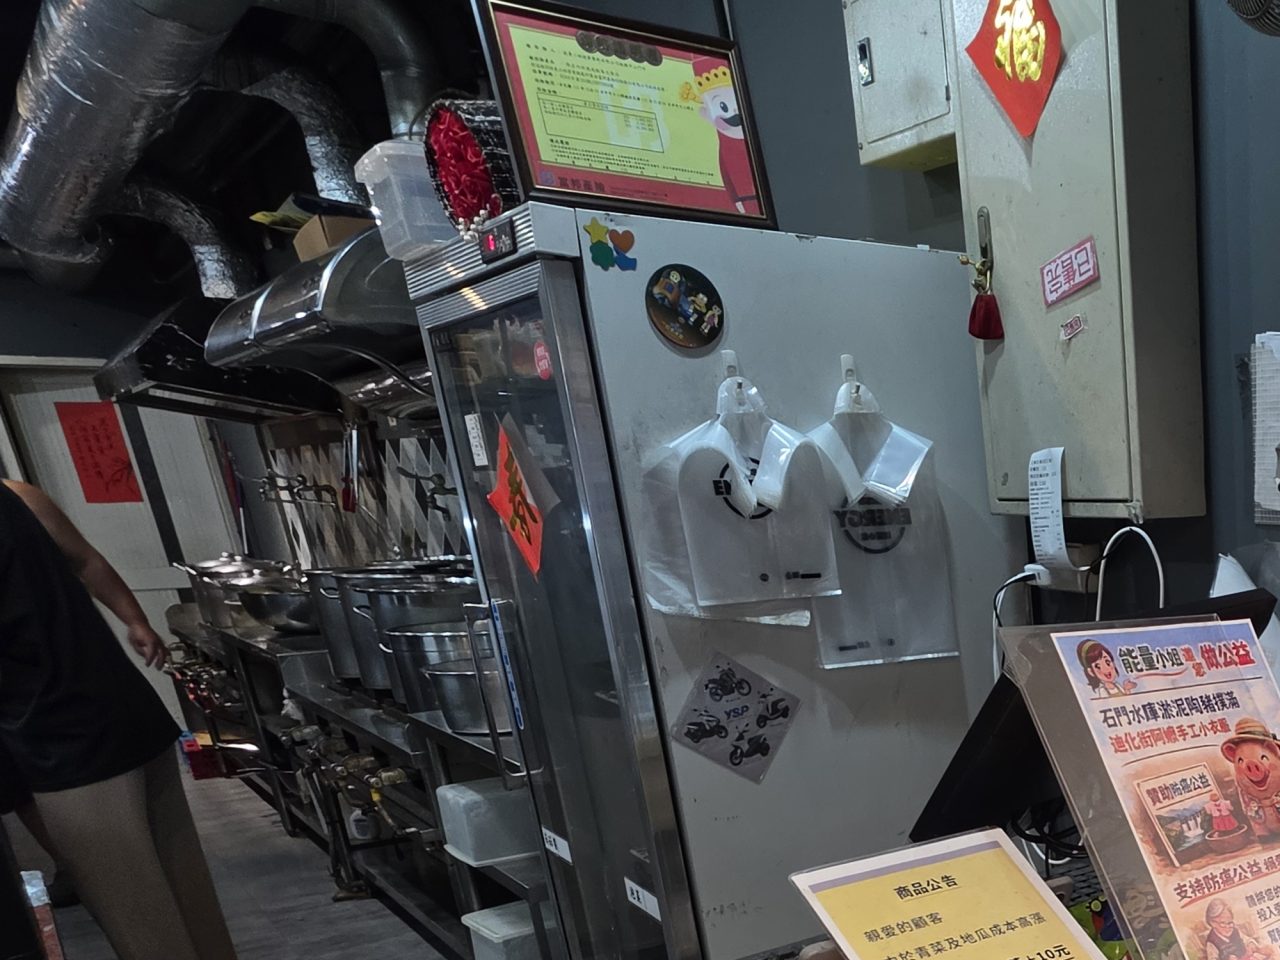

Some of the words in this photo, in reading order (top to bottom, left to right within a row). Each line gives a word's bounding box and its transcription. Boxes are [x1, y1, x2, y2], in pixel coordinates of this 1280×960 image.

[723, 704, 750, 721] YSP
[895, 874, 959, 900] 商品公告
[1173, 860, 1262, 902] 支持防癌公益
[863, 911, 944, 944] 親愛的顧客
